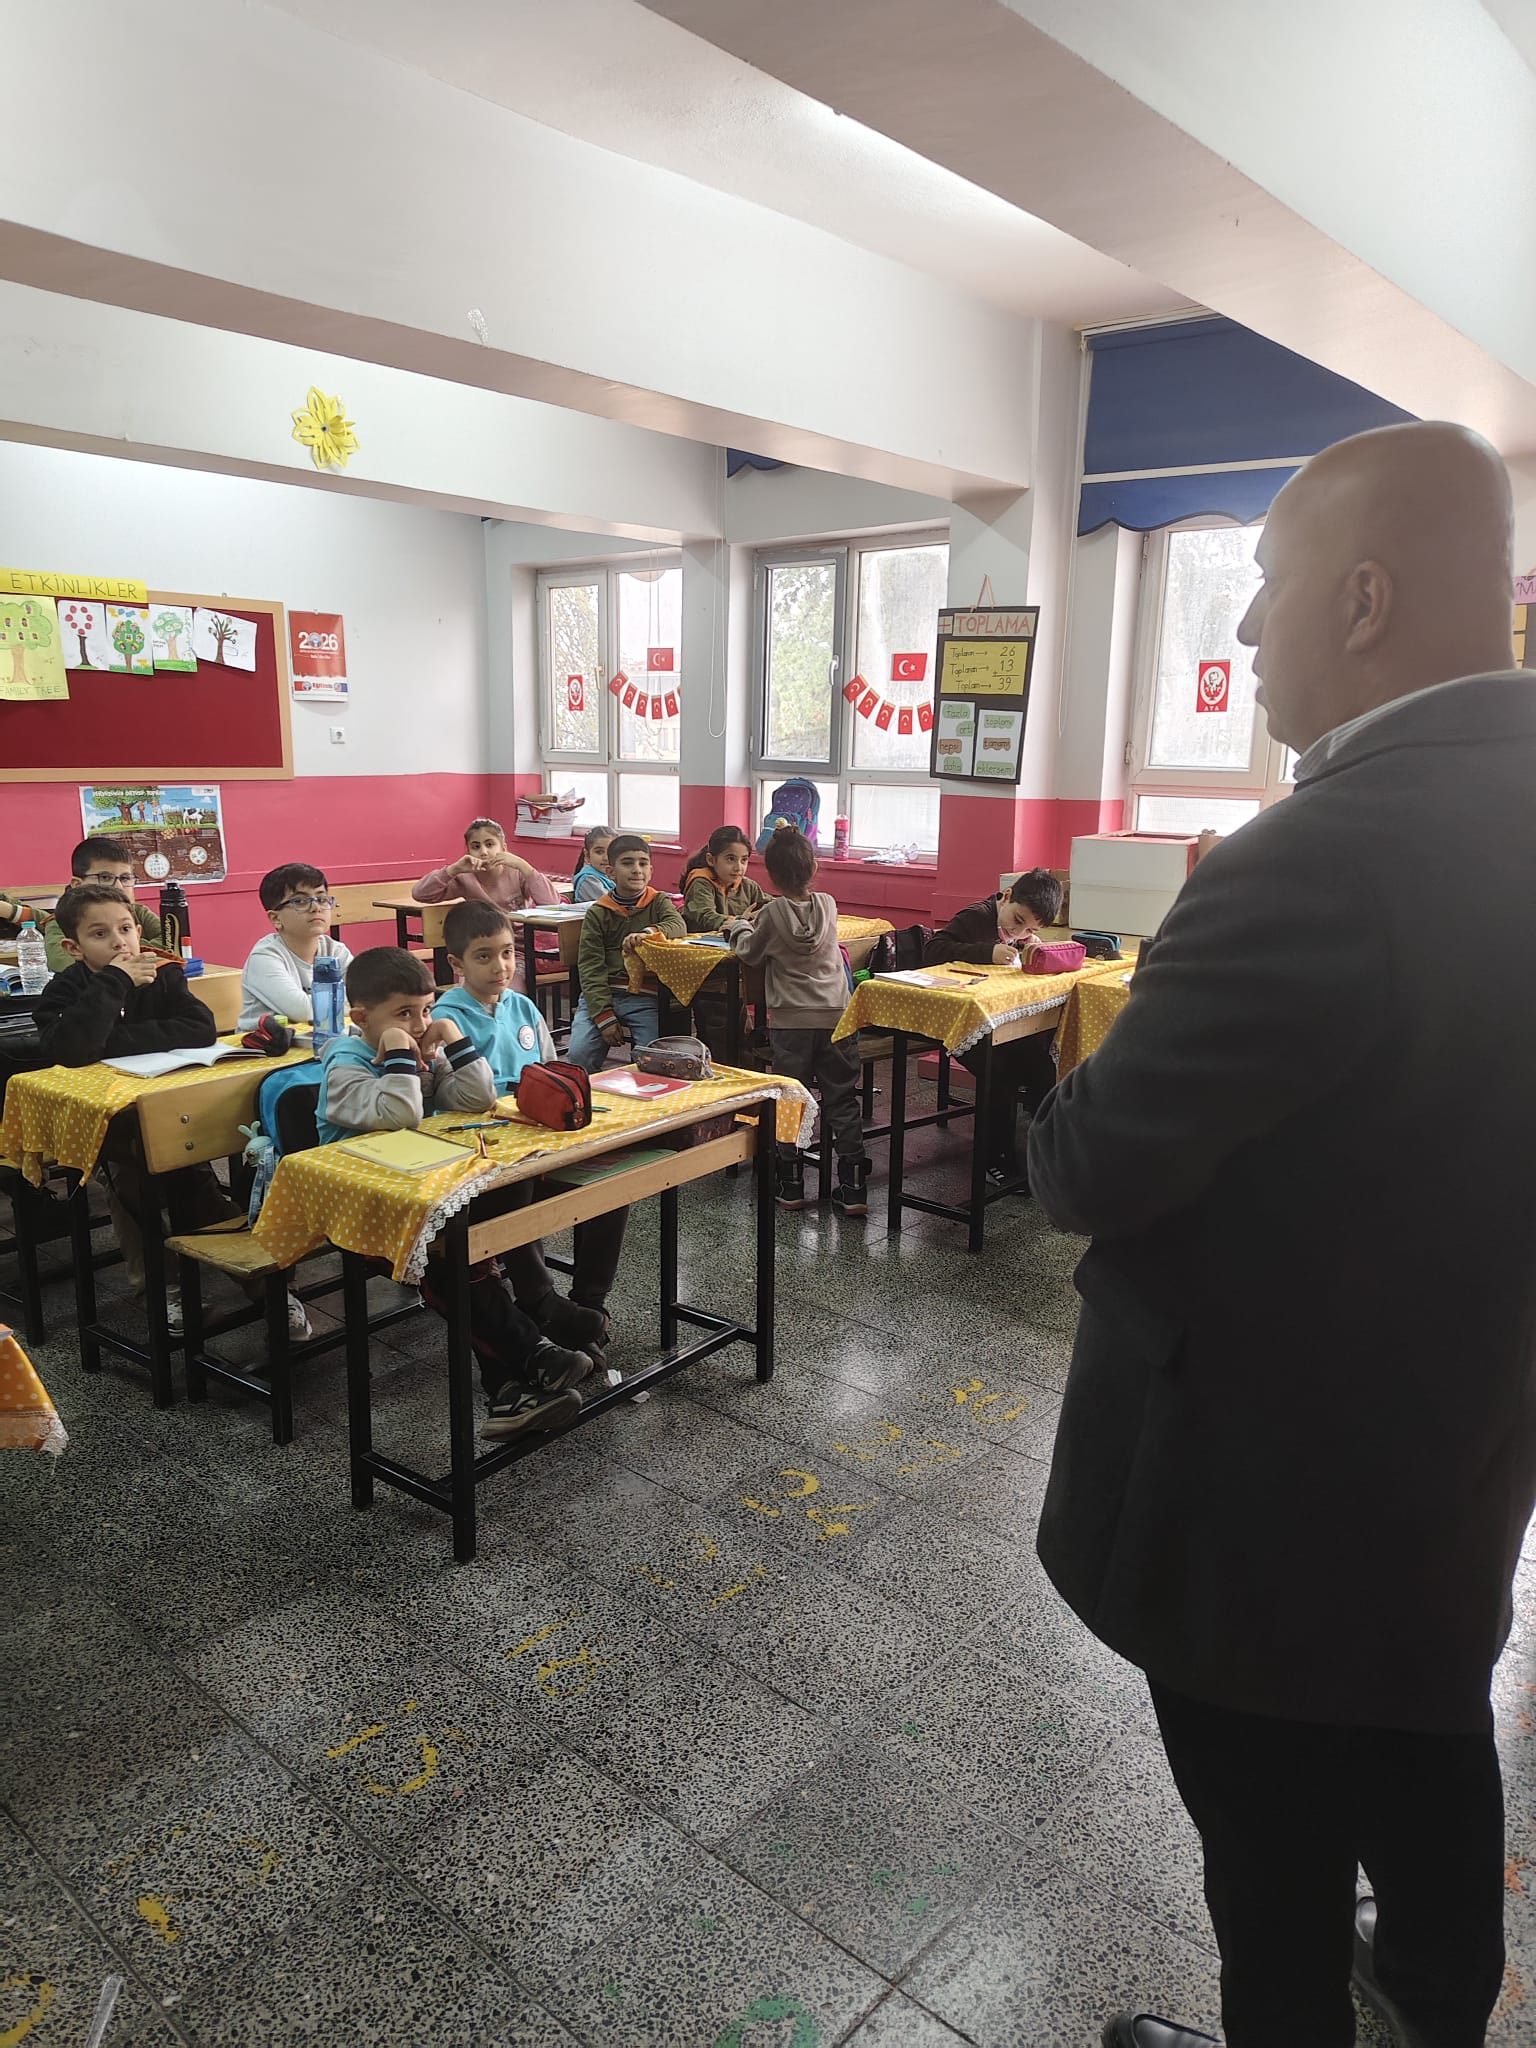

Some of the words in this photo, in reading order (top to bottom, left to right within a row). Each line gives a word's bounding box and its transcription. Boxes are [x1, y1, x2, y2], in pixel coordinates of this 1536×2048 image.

[956, 615, 1031, 635] TOPLAMA
[999, 645, 1016, 657] 26
[1000, 658, 1014, 672] 13
[998, 676, 1012, 692] 39
